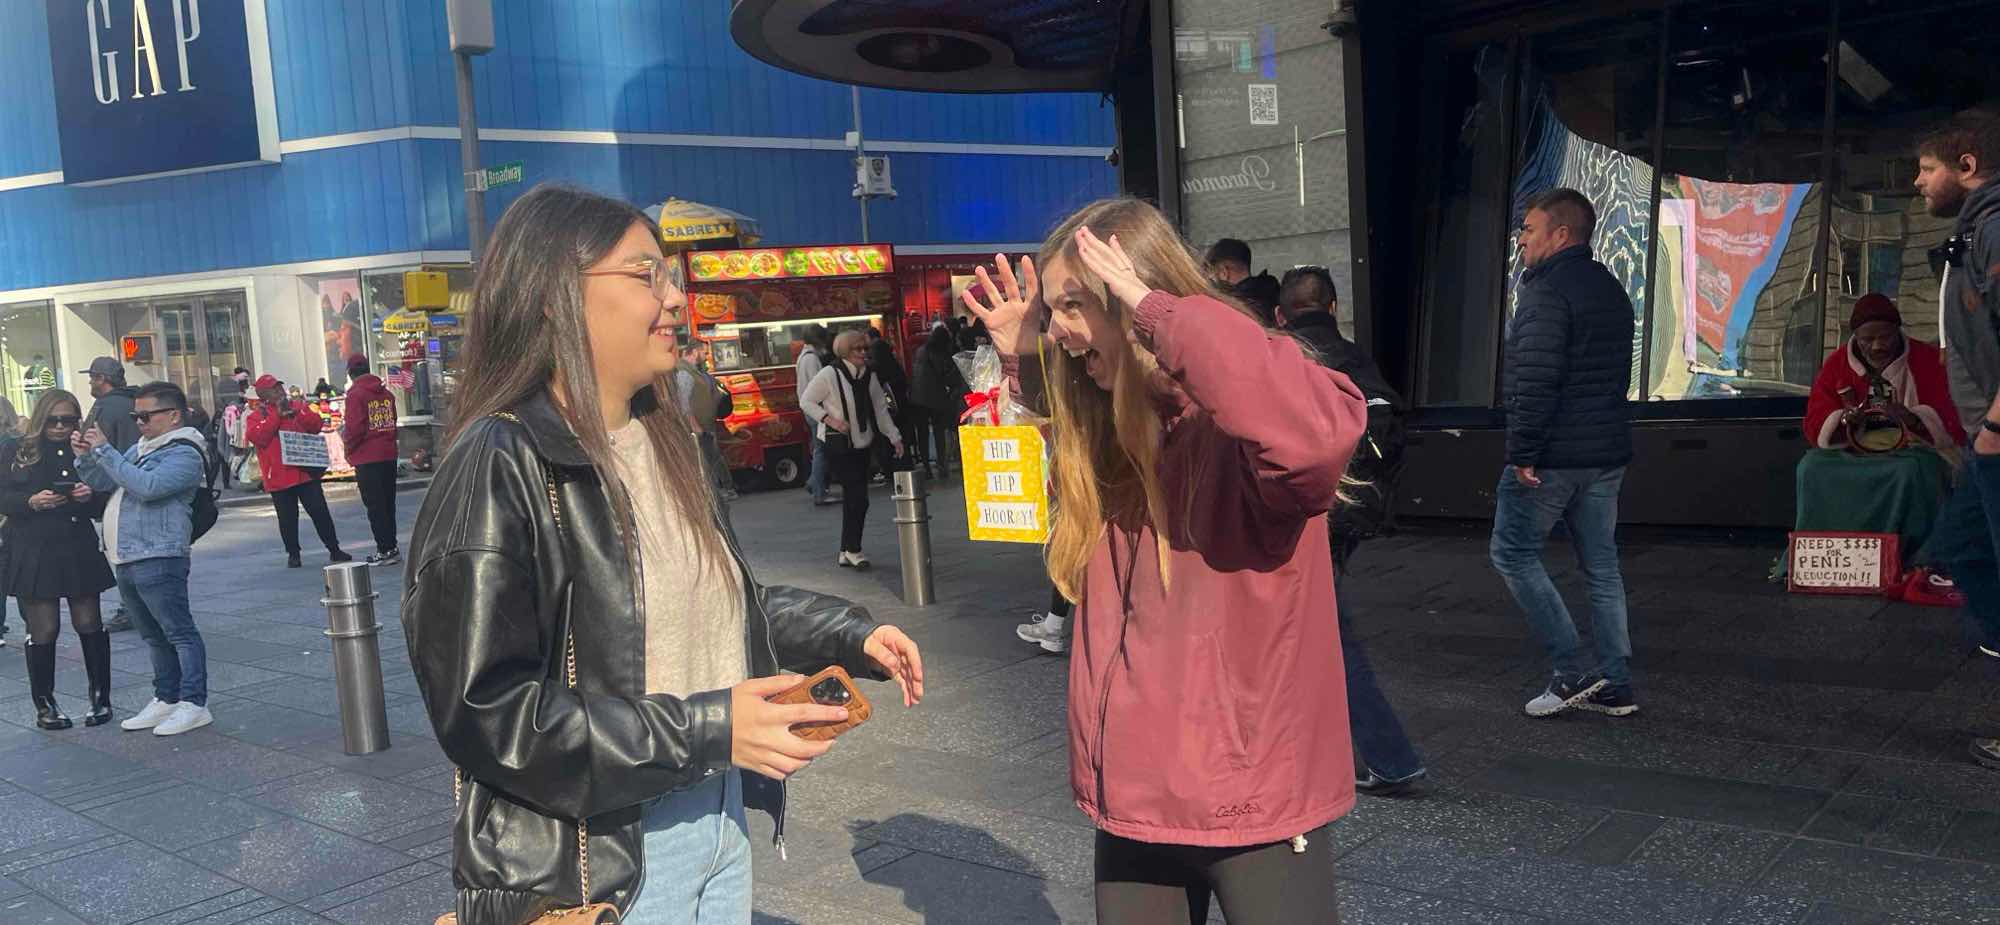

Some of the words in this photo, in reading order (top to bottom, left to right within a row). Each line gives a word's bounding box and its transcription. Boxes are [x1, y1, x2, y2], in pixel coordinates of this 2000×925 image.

[87, 0, 200, 104] GAP
[488, 164, 522, 184] Broadway
[664, 222, 732, 237] SABRETT
[990, 441, 1012, 459] HIP
[984, 507, 1033, 526] HOORY!
[1797, 539, 1834, 549] NEED
[1844, 538, 1878, 549] $$$$
[1799, 555, 1852, 568] PENIS
